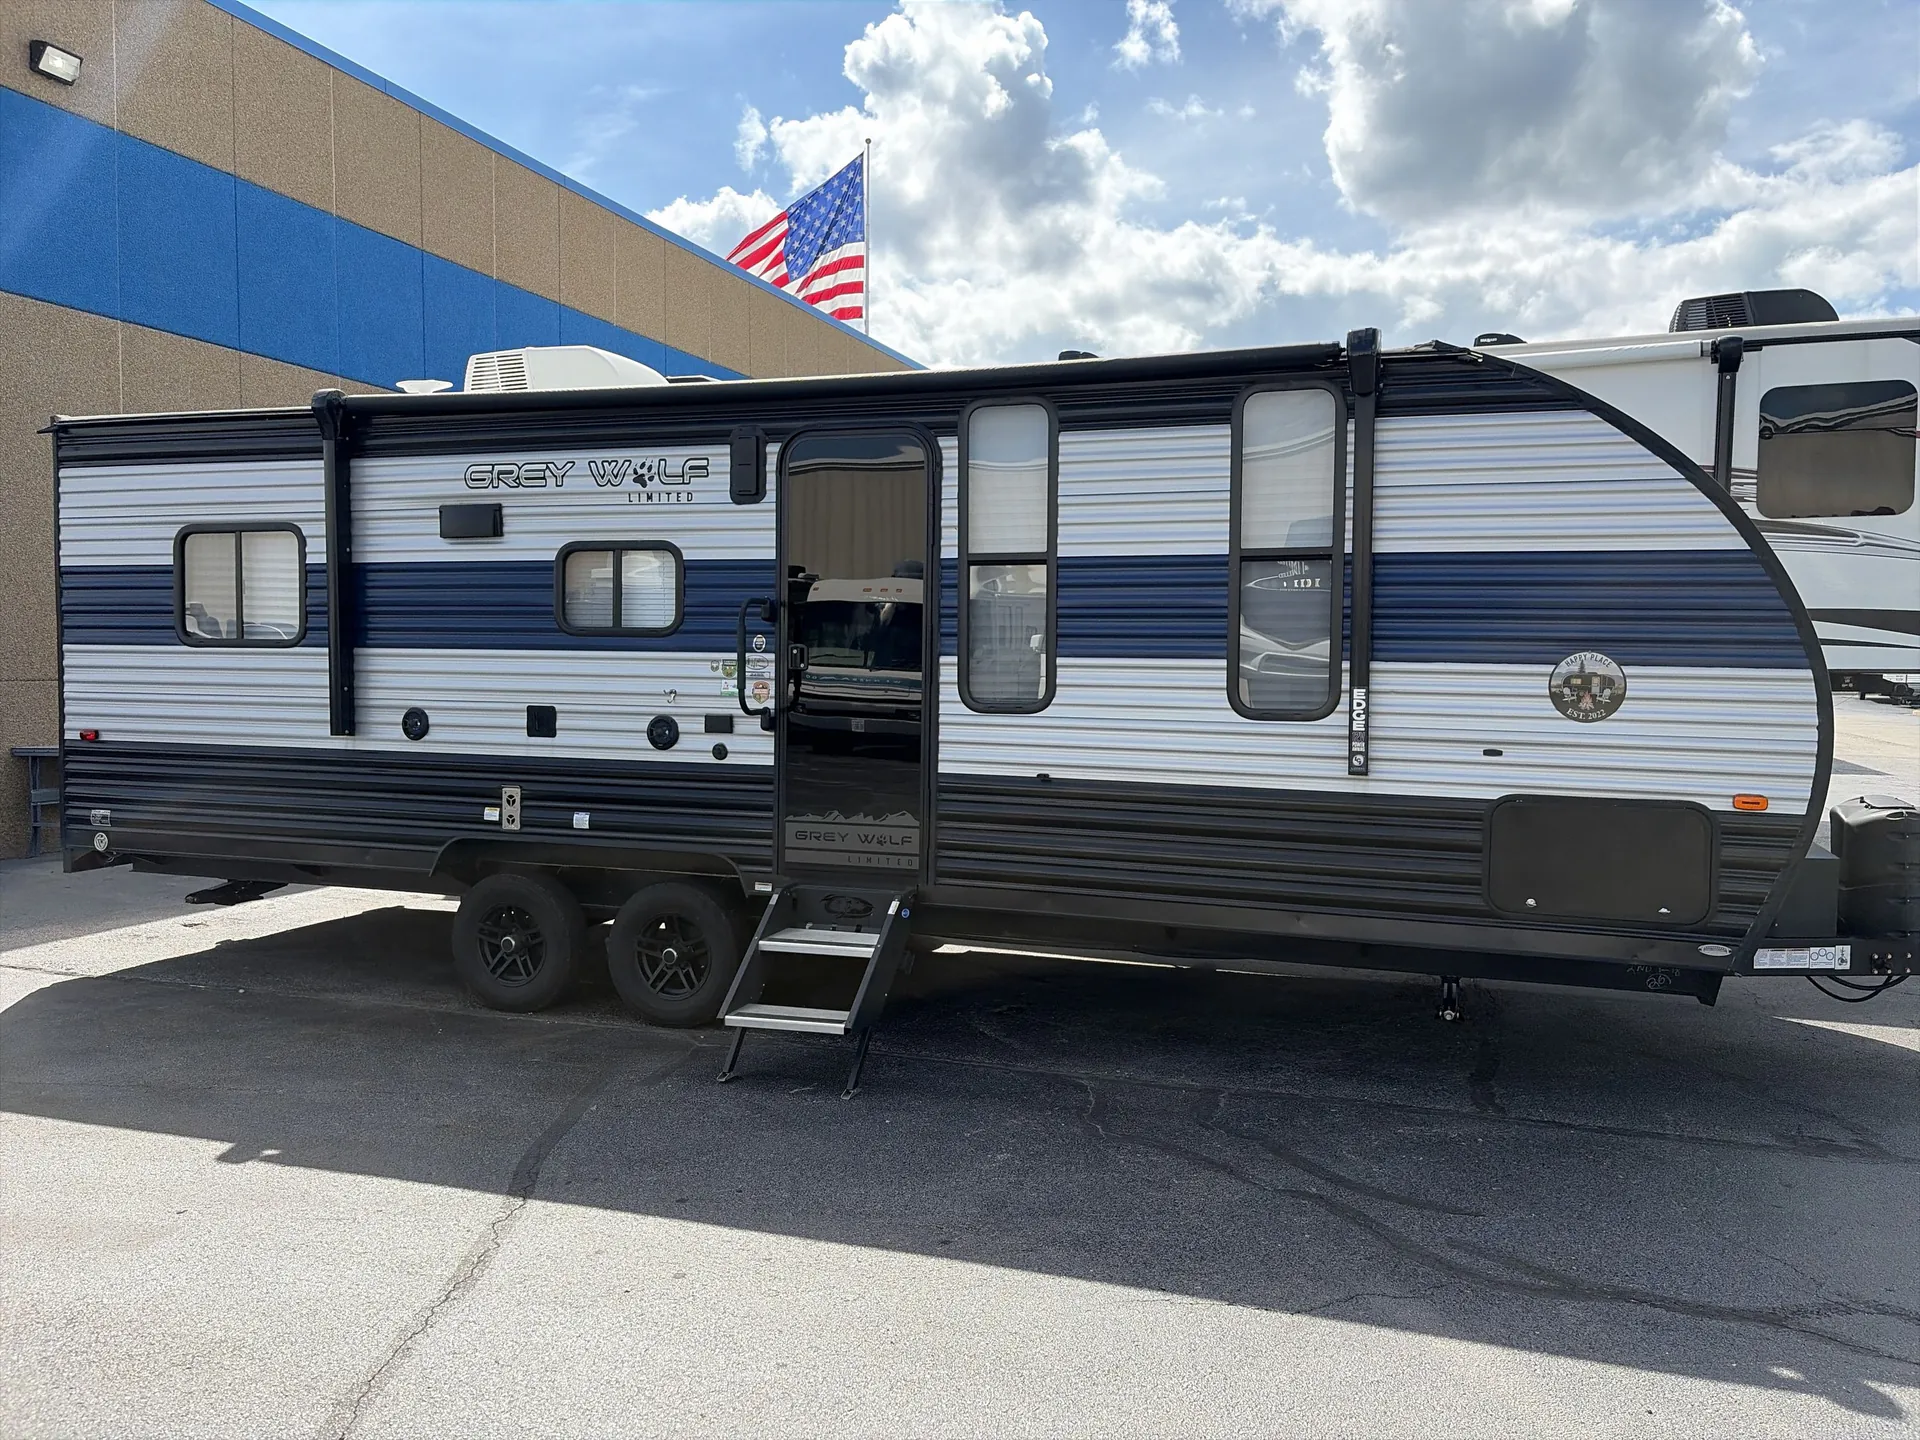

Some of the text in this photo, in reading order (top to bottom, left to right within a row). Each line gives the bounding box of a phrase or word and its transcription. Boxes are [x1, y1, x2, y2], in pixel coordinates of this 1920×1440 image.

[464, 461, 575, 489] GREY
[628, 492, 694, 503] LIMITED
[1564, 653, 1613, 668] HAPPY PLACE
[1352, 688, 1366, 731] EDGE
[1566, 707, 1607, 719] EST. 2022
[795, 830, 849, 842] GREY
[847, 855, 913, 867] LIMITED
